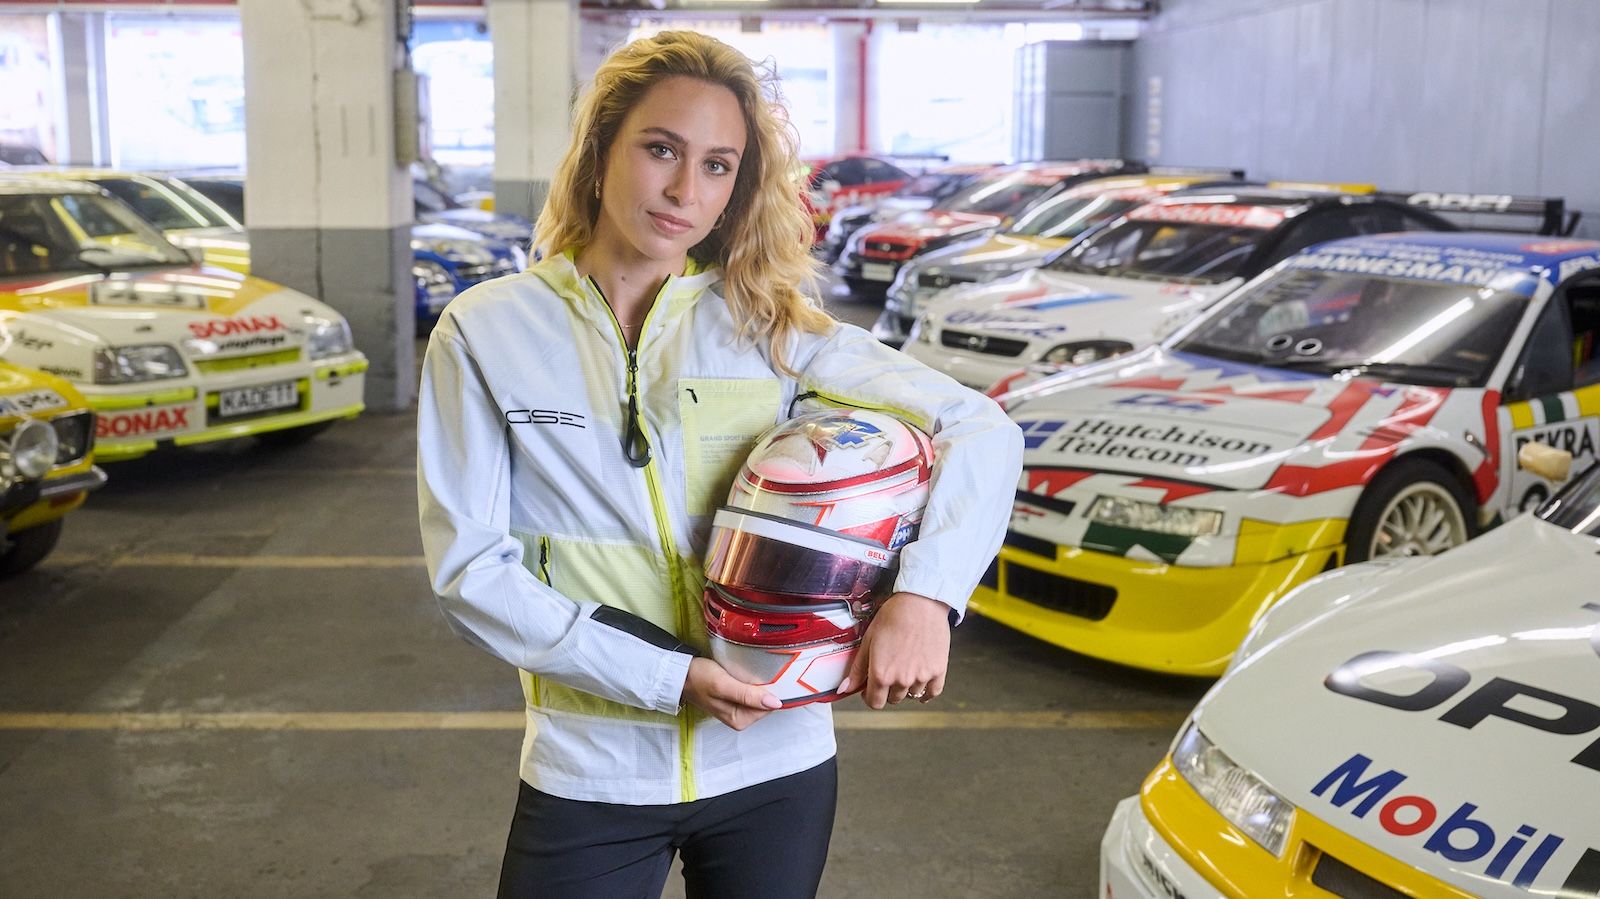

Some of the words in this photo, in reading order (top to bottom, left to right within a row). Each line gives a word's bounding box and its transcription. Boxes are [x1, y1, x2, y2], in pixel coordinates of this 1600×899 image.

[222, 382, 298, 411] KADETT
[95, 406, 189, 438] SONAX
[505, 409, 586, 429] GSE
[1055, 435, 1210, 467] Telecom
[1071, 419, 1272, 455] Hutchison
[867, 550, 887, 561] BELL
[1323, 650, 1600, 772] OP
[1311, 753, 1564, 888] Mobil
